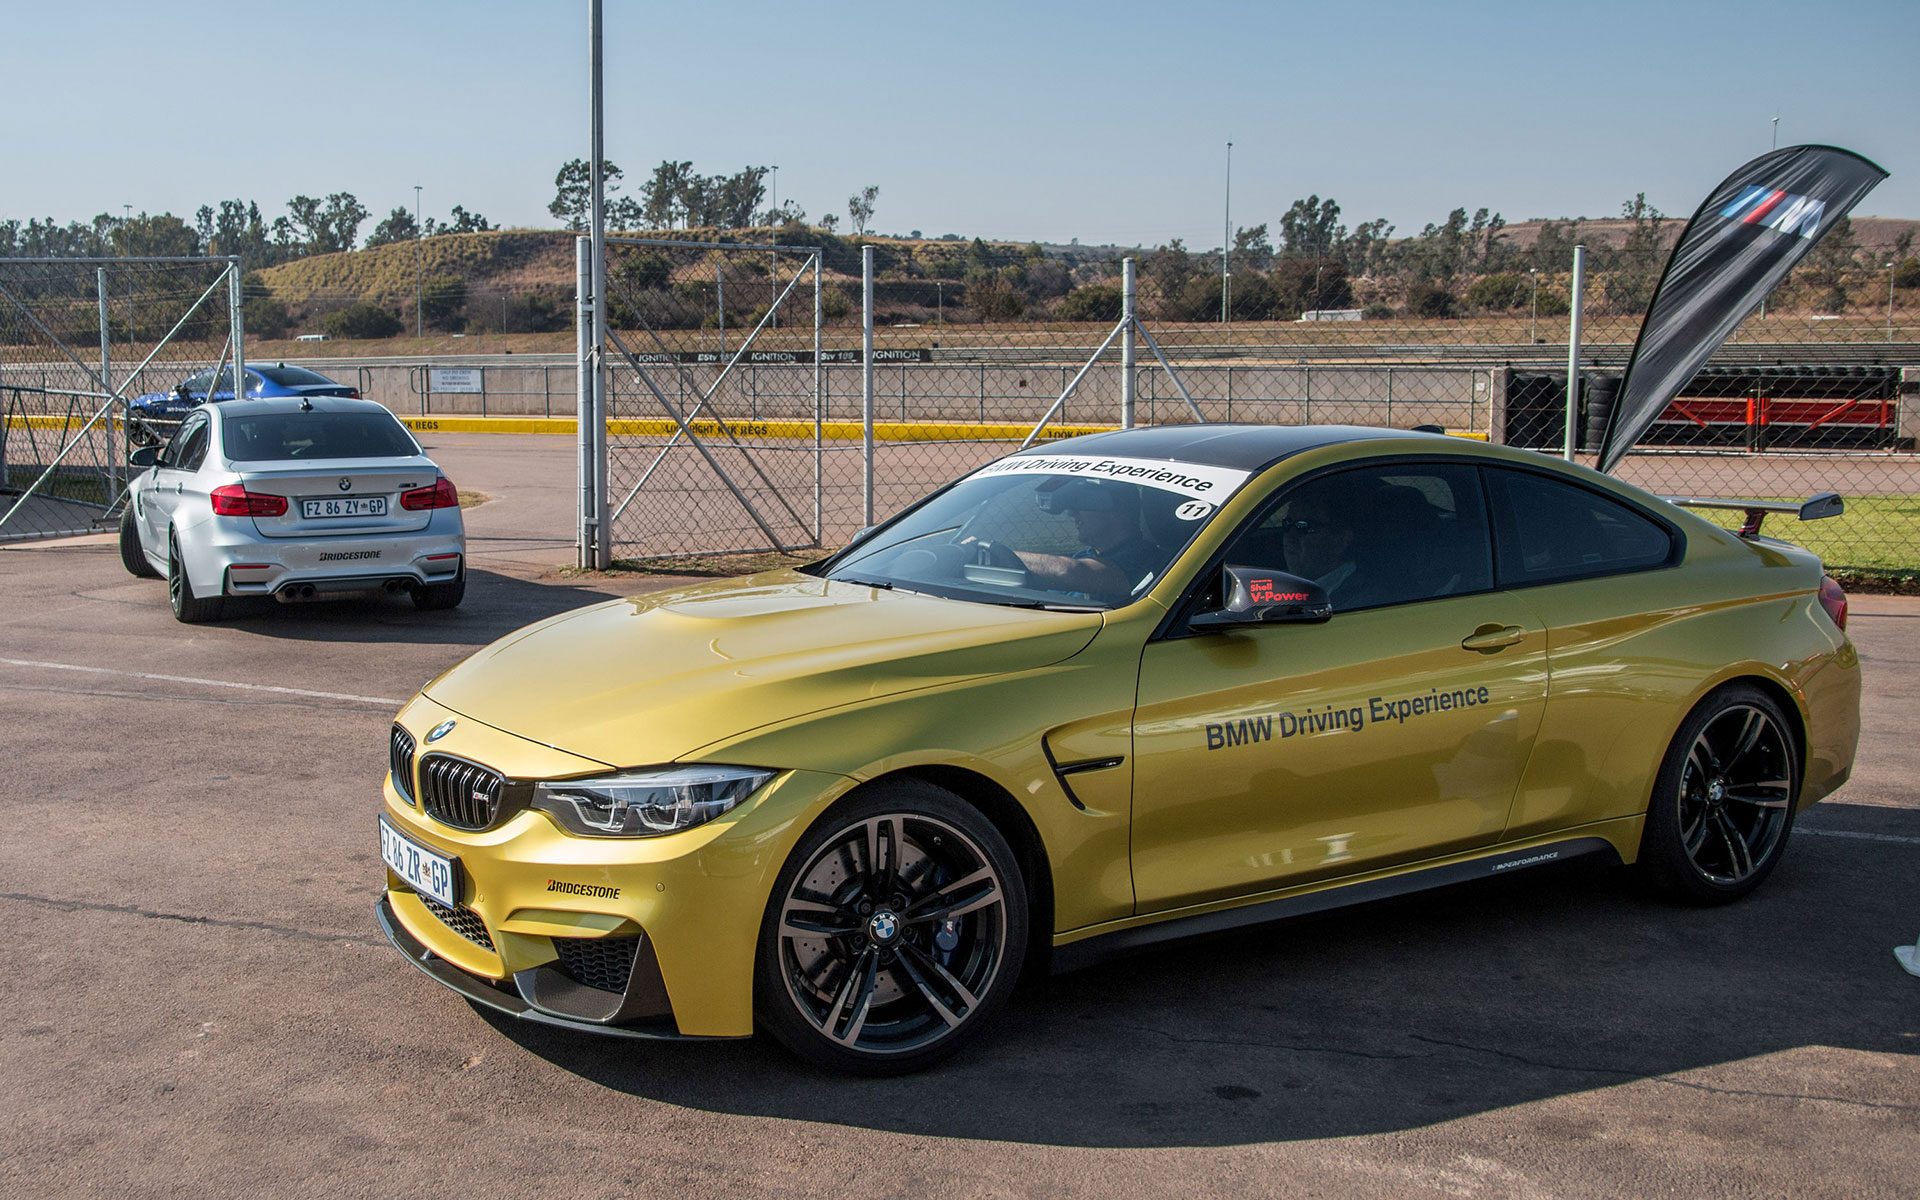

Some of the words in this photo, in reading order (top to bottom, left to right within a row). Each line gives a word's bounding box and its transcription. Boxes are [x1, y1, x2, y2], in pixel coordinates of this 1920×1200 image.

[751, 352, 796, 361] IGNITION
[872, 350, 920, 359] IGNITION
[416, 421, 439, 430] REGS
[1024, 458, 1087, 473] Driving
[1091, 460, 1214, 492] Experience
[306, 502, 321, 516] FZ
[326, 502, 340, 514] 86
[345, 501, 359, 514] ZY
[369, 500, 383, 513] GP
[1184, 503, 1206, 518] 11
[319, 550, 382, 561] BRIDGESTONE
[1250, 583, 1273, 592] Shell
[1250, 591, 1309, 603] V-Power
[1205, 715, 1273, 751] BMW
[1279, 705, 1364, 738] Driving
[1368, 686, 1490, 724] Experience
[392, 836, 404, 872] 86
[406, 845, 422, 884] ZR
[432, 859, 449, 897] GP
[547, 879, 621, 900] BRIDGESTONE
